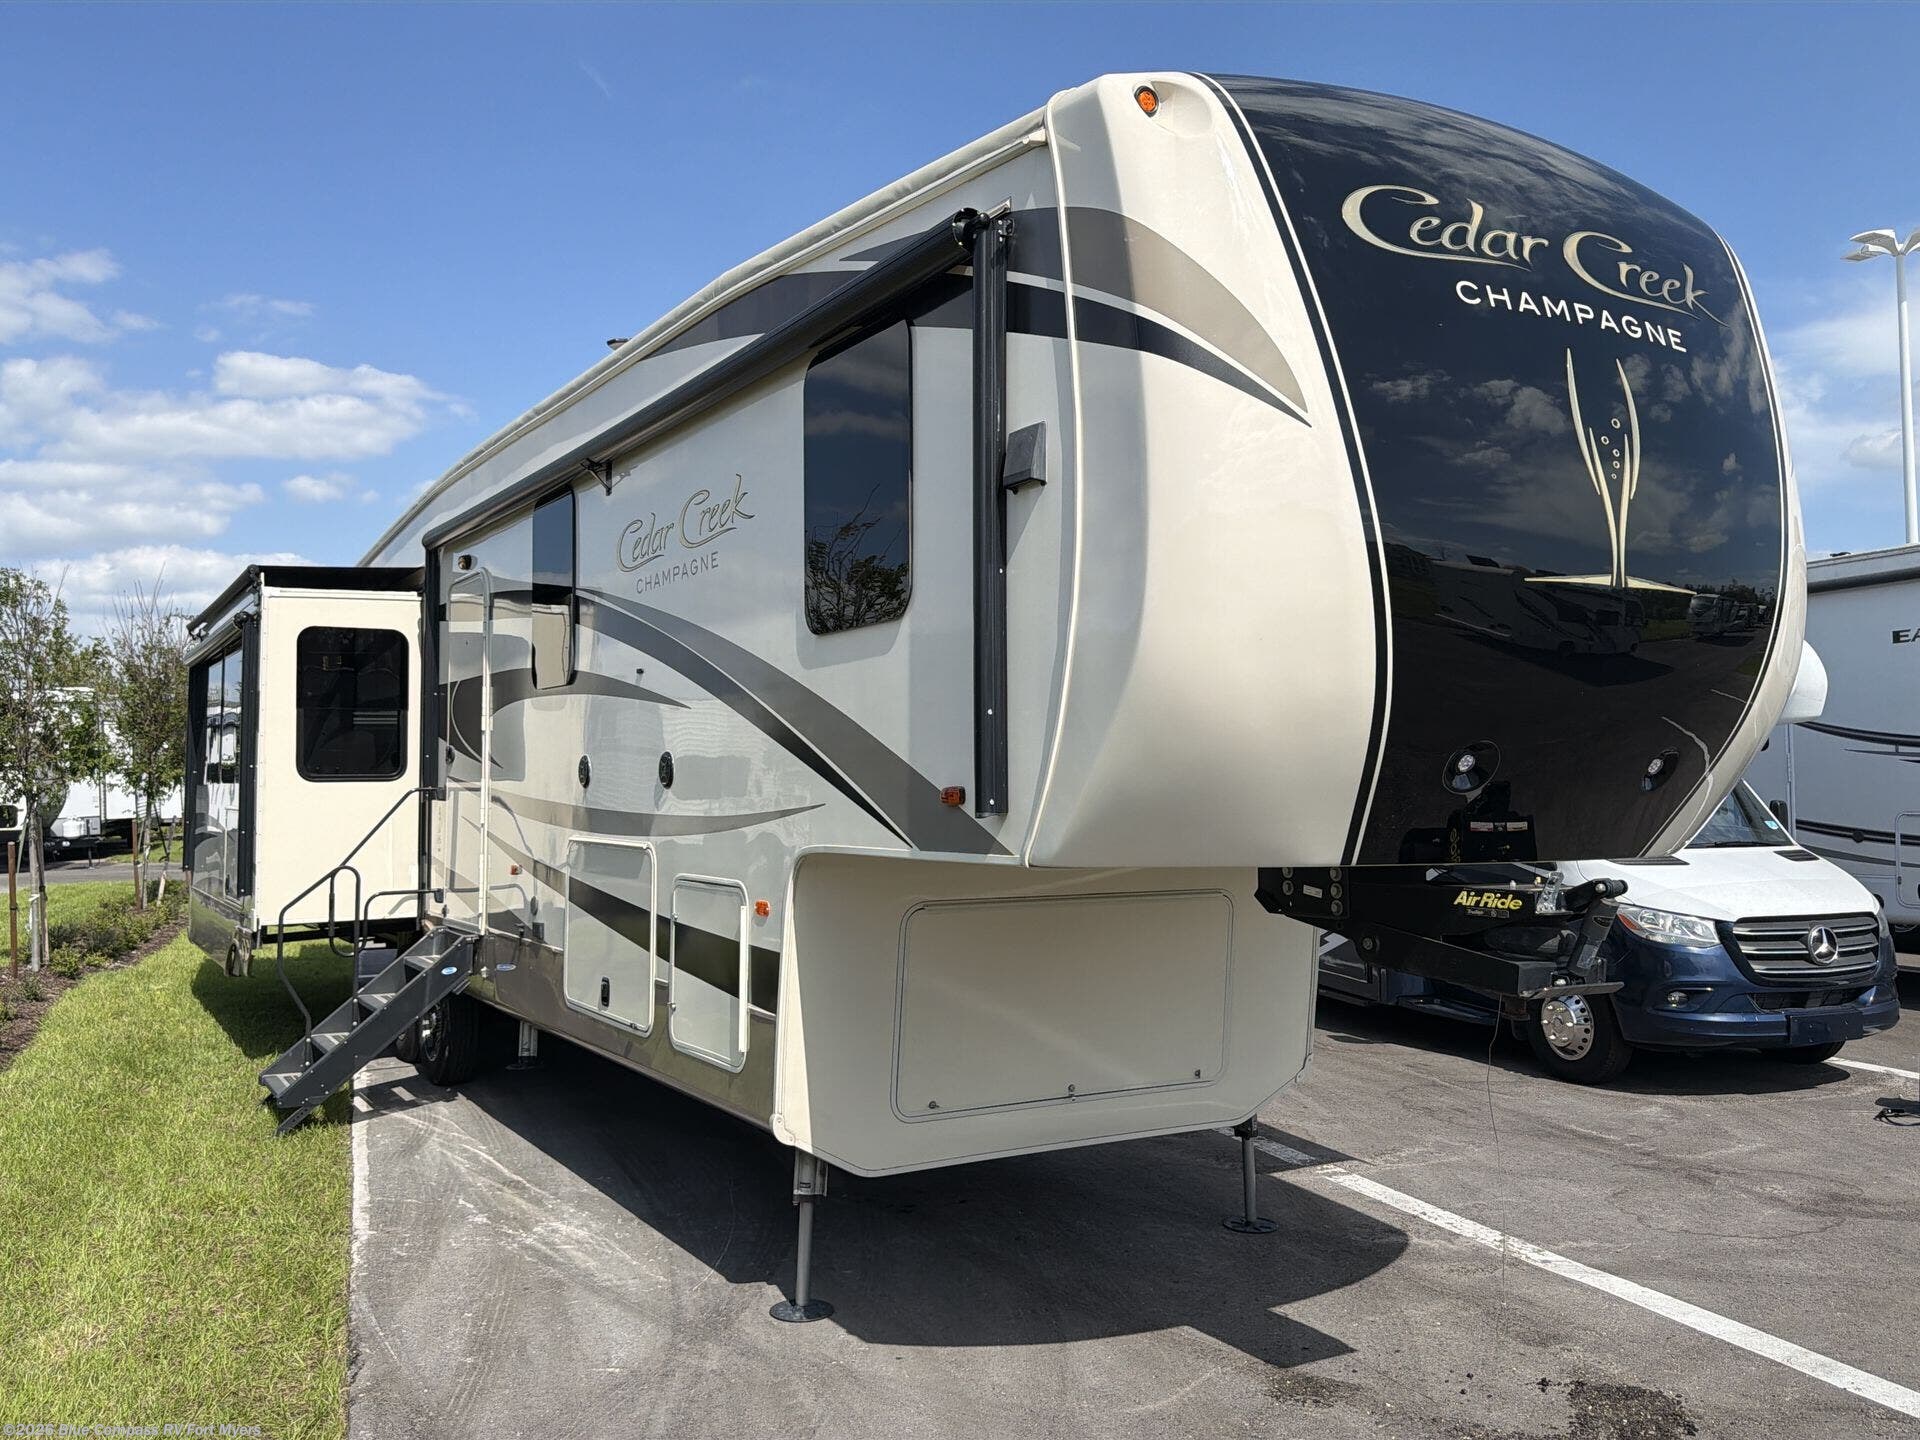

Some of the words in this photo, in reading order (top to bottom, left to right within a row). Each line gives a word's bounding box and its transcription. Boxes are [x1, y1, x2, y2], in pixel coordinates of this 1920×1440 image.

[1341, 184, 1549, 272] Cedar
[1562, 230, 1730, 328] Creek
[1455, 280, 1688, 354] CHAMPAGNE
[616, 512, 675, 573] Cedar
[679, 473, 755, 549] Creek
[636, 551, 720, 595] CHAMPAGNE
